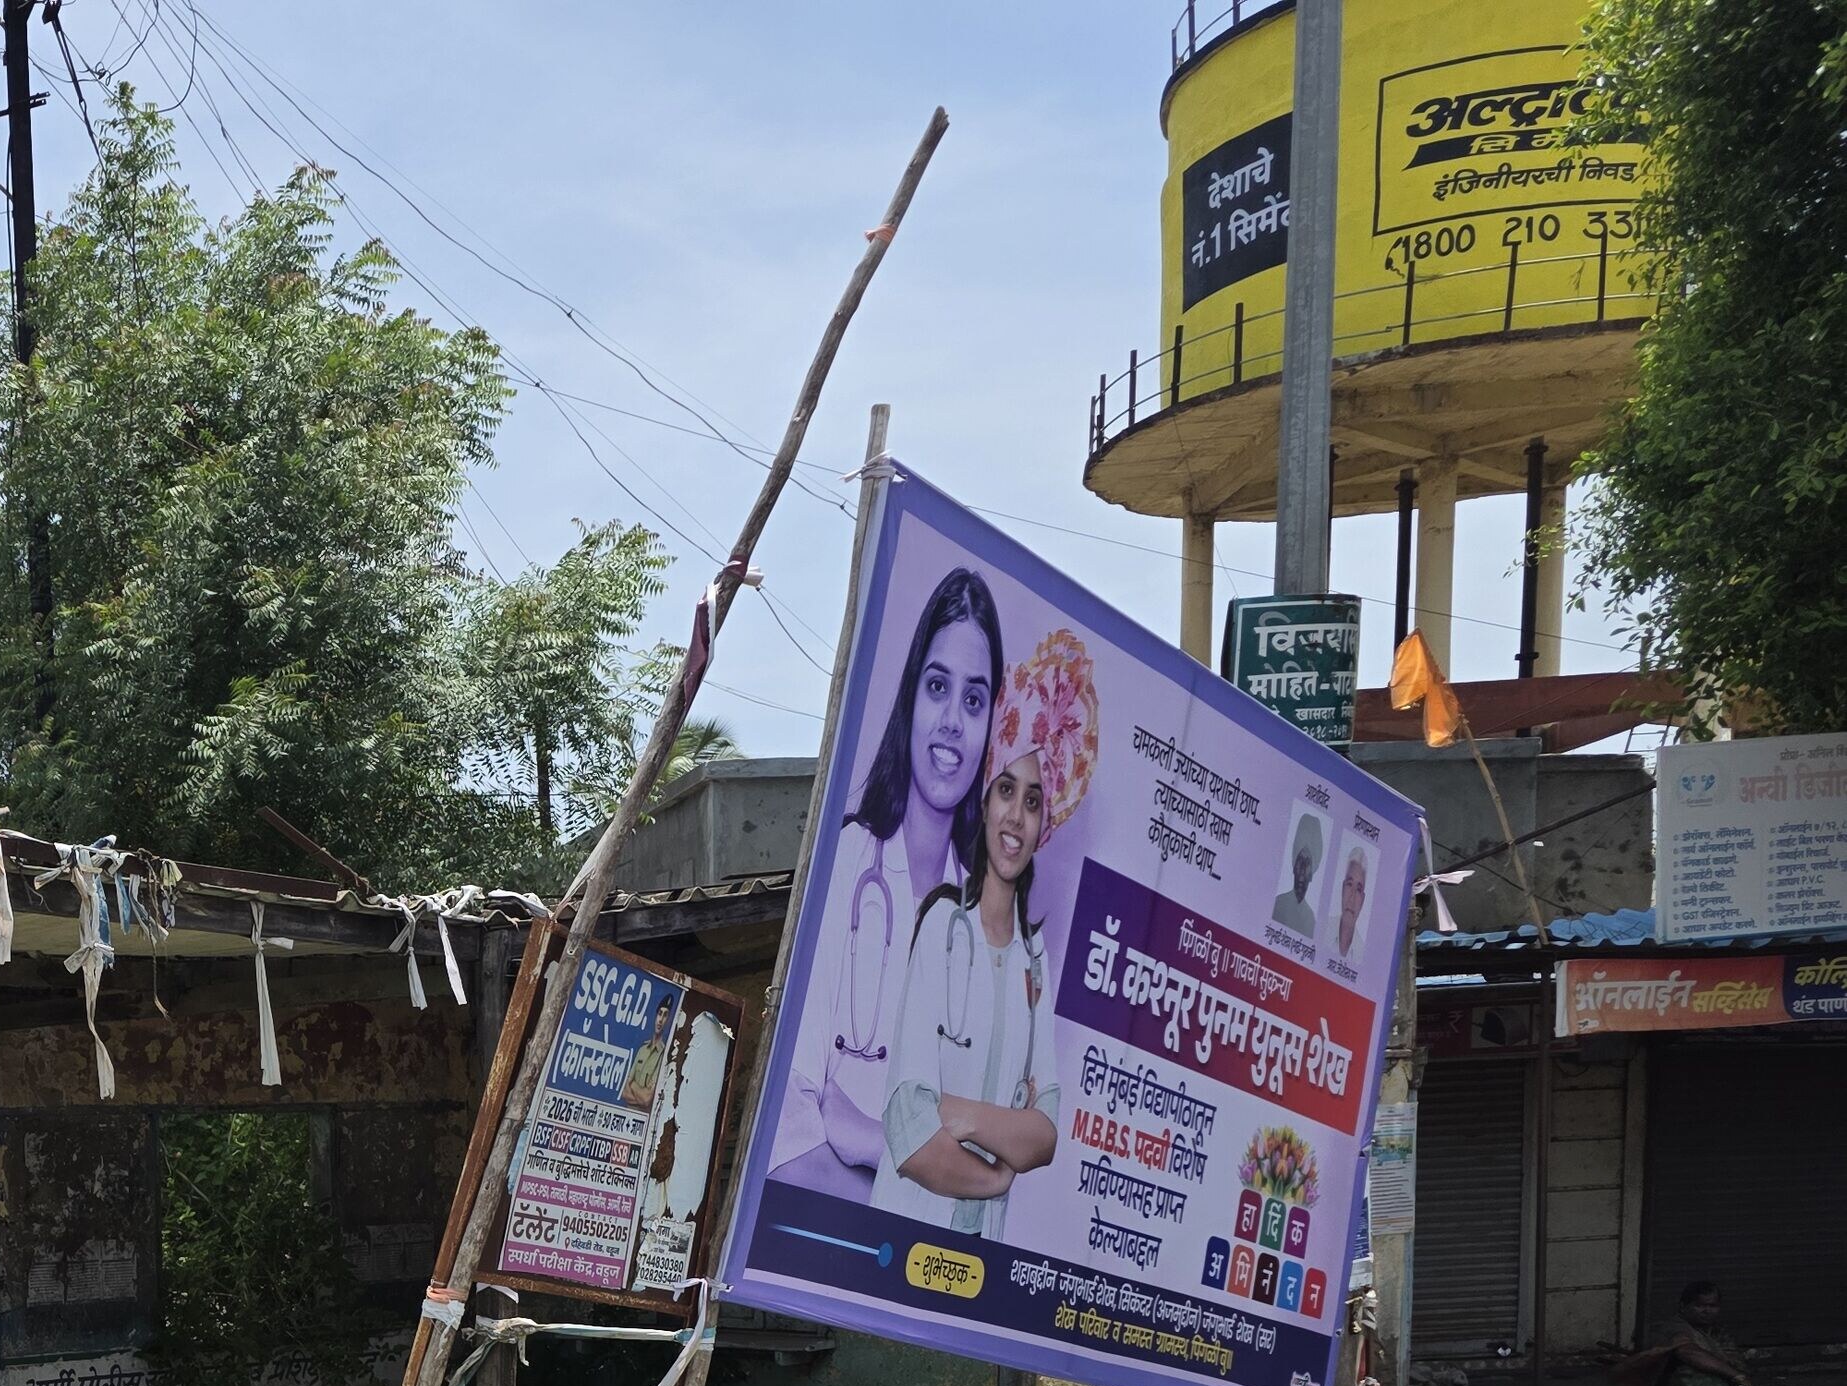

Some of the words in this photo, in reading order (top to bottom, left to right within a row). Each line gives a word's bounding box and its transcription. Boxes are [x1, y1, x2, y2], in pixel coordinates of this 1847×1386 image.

[1208, 147, 1274, 208] देशाचे
[1432, 159, 1574, 201] इंजिनीयरची
[1580, 156, 1637, 182] निवड
[1401, 224, 1476, 263] 1800
[1503, 214, 1560, 246] 210
[1295, 707, 1336, 720] खासदार
[1133, 725, 1176, 771] चमकली
[1174, 750, 1209, 792] ज्यांच्या
[1209, 771, 1241, 811] यशाची
[1148, 812, 1196, 864] कौतुकाची
[1154, 780, 1211, 832] त्यांच्यासाठी
[1210, 812, 1234, 846] खास
[1179, 919, 1211, 963] पिंगळी
[1230, 951, 1261, 987] गावची
[1259, 965, 1293, 1001] सुकन्या
[575, 960, 652, 1030] SSC-G.D.
[1084, 915, 1120, 997] डॉ.
[1195, 982, 1253, 1063] पुनम
[1251, 1006, 1309, 1095] युनूस
[1306, 1017, 1353, 1096] शेख
[1575, 970, 1697, 1016] ऑनलाईन
[1692, 981, 1774, 1014] सर्व्हिसेस
[1793, 995, 1817, 1014] थंड
[547, 1096, 574, 1122] 2026
[1080, 1045, 1108, 1095] हिने
[1108, 1058, 1141, 1116] मुंबई
[1139, 1069, 1217, 1147] विद्यापीठातून
[527, 1150, 549, 1172] गणित
[590, 1163, 607, 1184] शॉर्ट
[534, 1125, 551, 1146] BSF
[552, 1129, 571, 1150] CISF
[569, 1134, 590, 1156] CRPF
[590, 1138, 611, 1160] ITBP
[612, 1143, 628, 1164] SSB
[1071, 1108, 1131, 1159] M.B.B.S.
[1135, 1128, 1171, 1172] पदवी
[1168, 1133, 1208, 1184] विशेष
[1078, 1155, 1155, 1218] प्राविण्यासह
[1154, 1186, 1187, 1224] प्राप्त
[512, 1202, 559, 1243] टॅलेंट
[562, 1216, 628, 1242] 9405502205
[1088, 1206, 1162, 1271] केल्याबद्दल
[508, 1248, 539, 1266] स्पर्धा
[538, 1251, 573, 1272] परीक्षा
[1010, 1259, 1057, 1296] शहाबुद्दीन
[1059, 1268, 1096, 1306] जंगुभाई
[1095, 1277, 1117, 1312] शेख,
[1118, 1283, 1153, 1316] सिकंदर
[1202, 1306, 1237, 1341] जंगुभाई
[1236, 1317, 1254, 1345] शेख
[1256, 1322, 1277, 1355] (सर)
[1055, 1300, 1076, 1331] शेख
[1079, 1308, 1111, 1341] परिवार
[1112, 1320, 1120, 1343] व
[1123, 1324, 1155, 1350] समस्त
